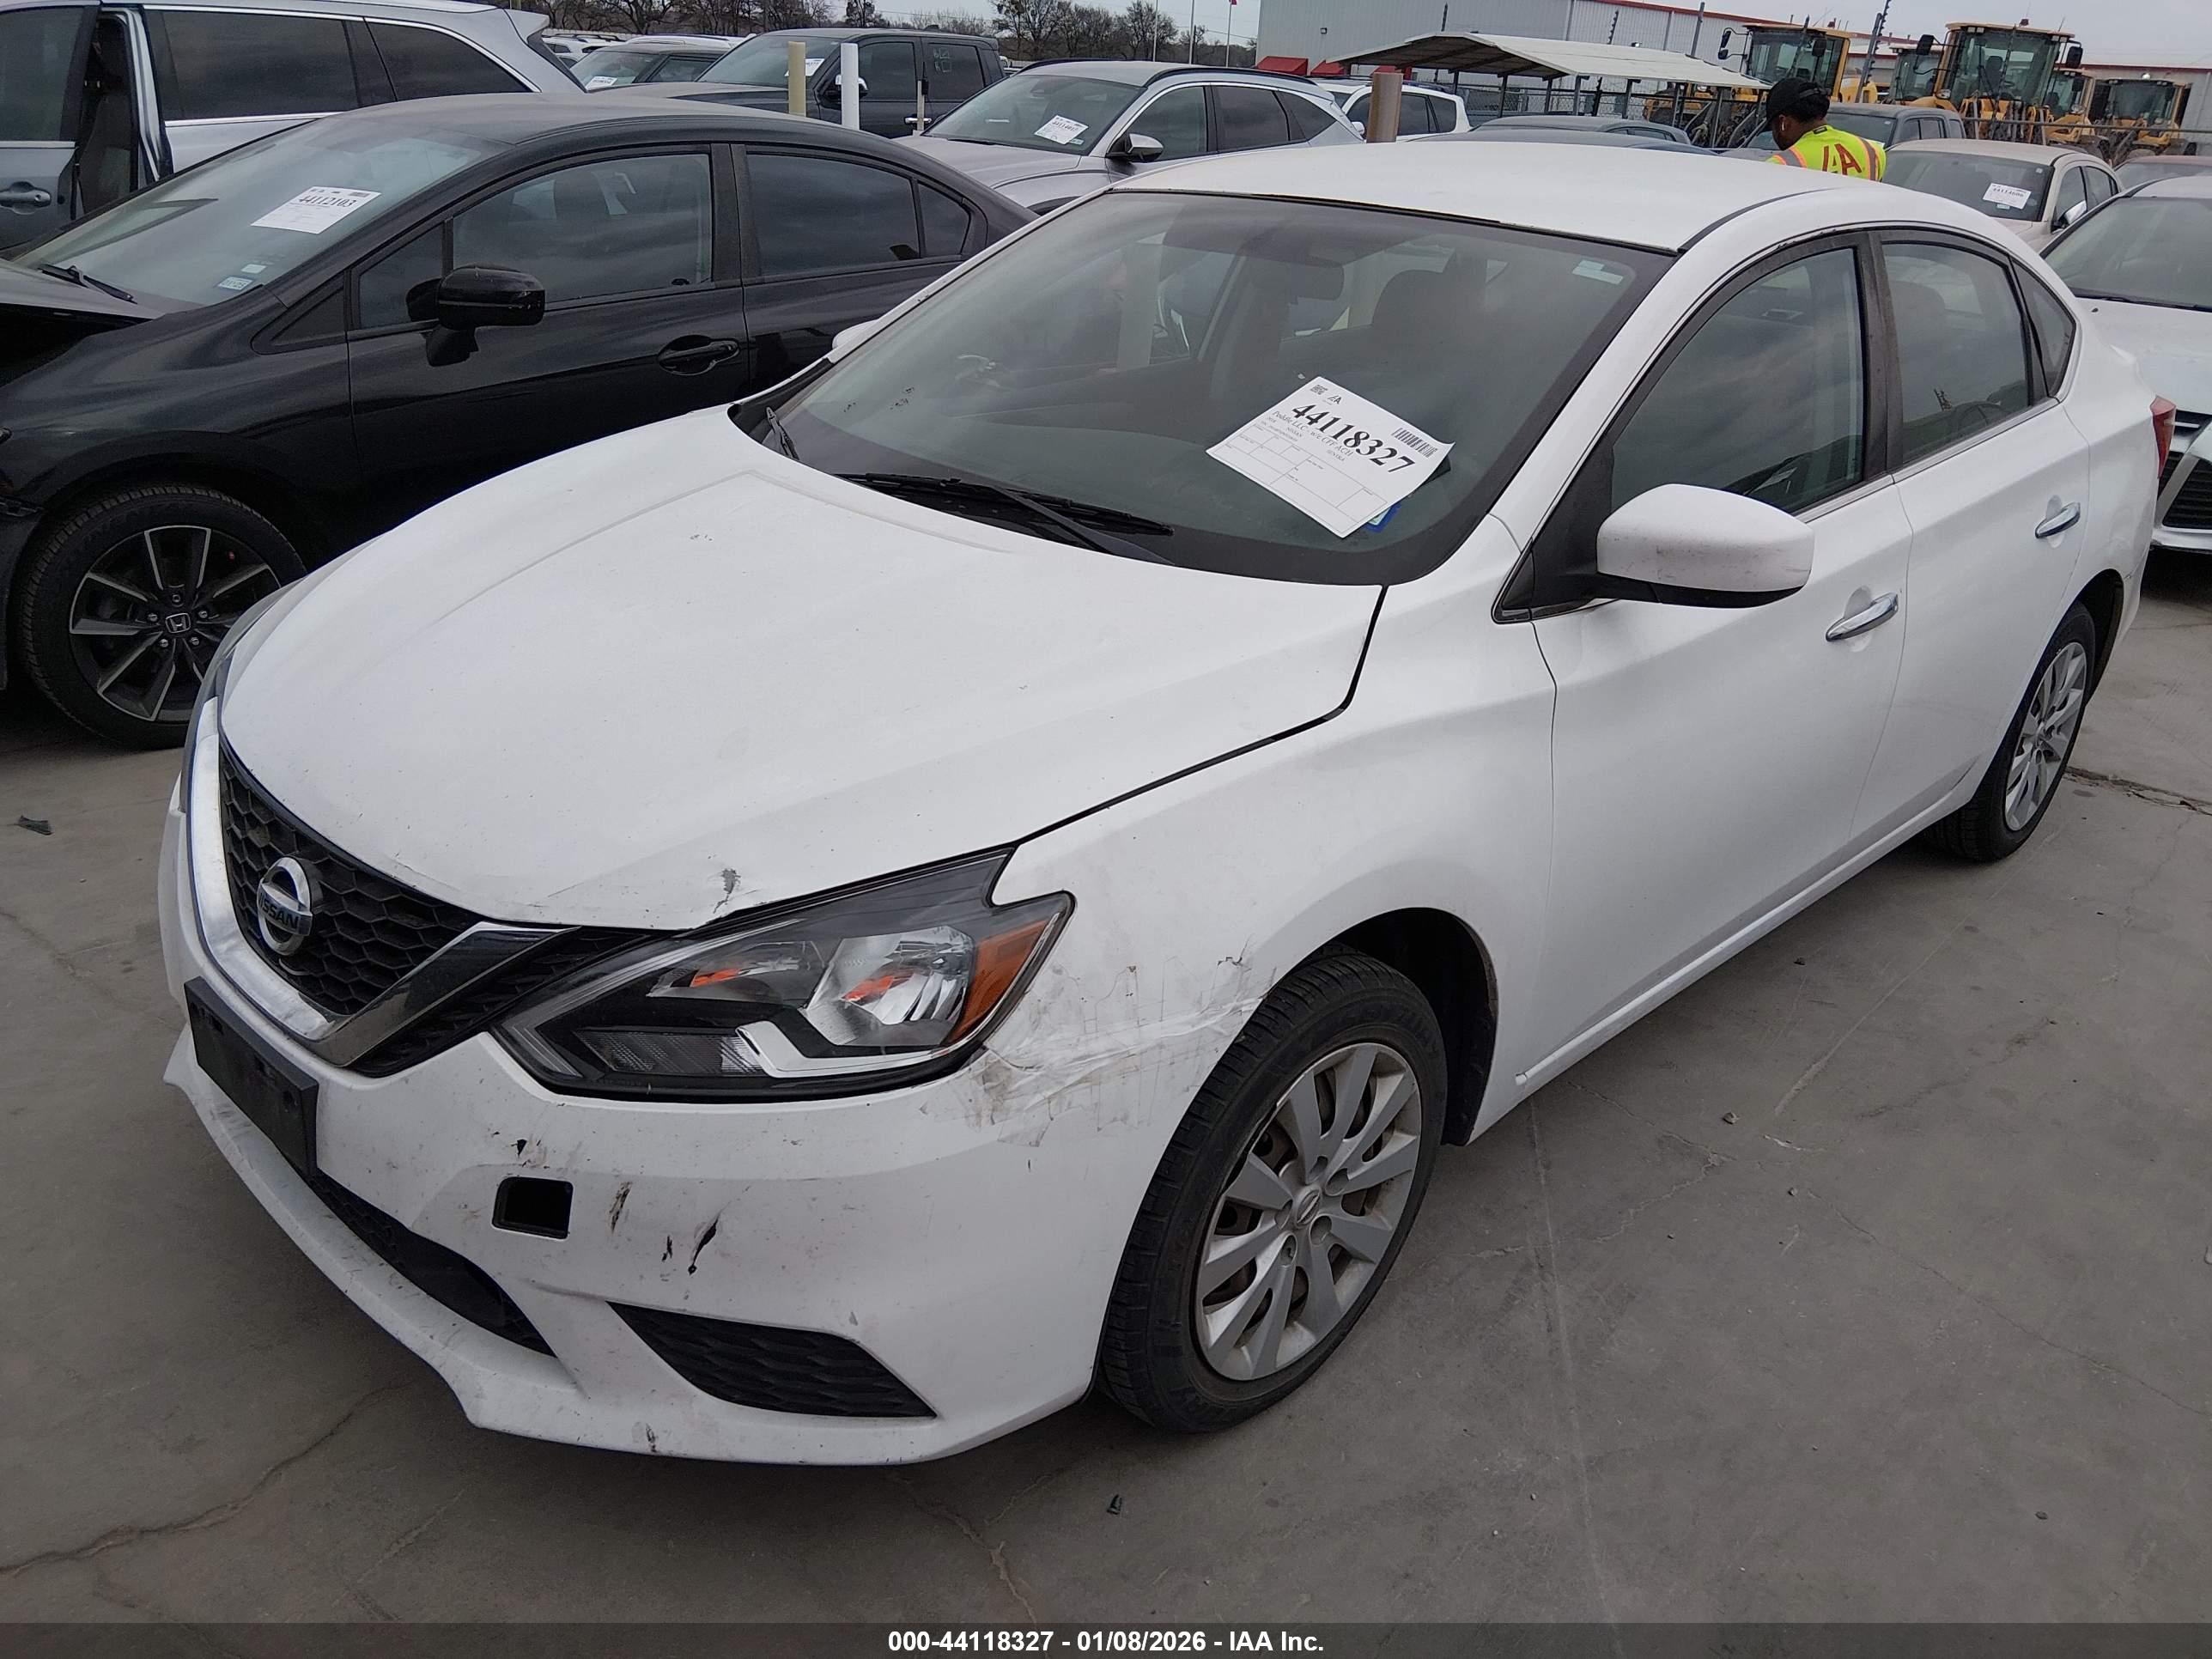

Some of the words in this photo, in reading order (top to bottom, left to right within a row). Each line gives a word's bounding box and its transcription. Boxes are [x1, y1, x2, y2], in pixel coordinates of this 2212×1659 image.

[299, 195, 357, 207] 44112103
[1291, 420, 1309, 430] LLC
[1291, 404, 1415, 472] 44118327
